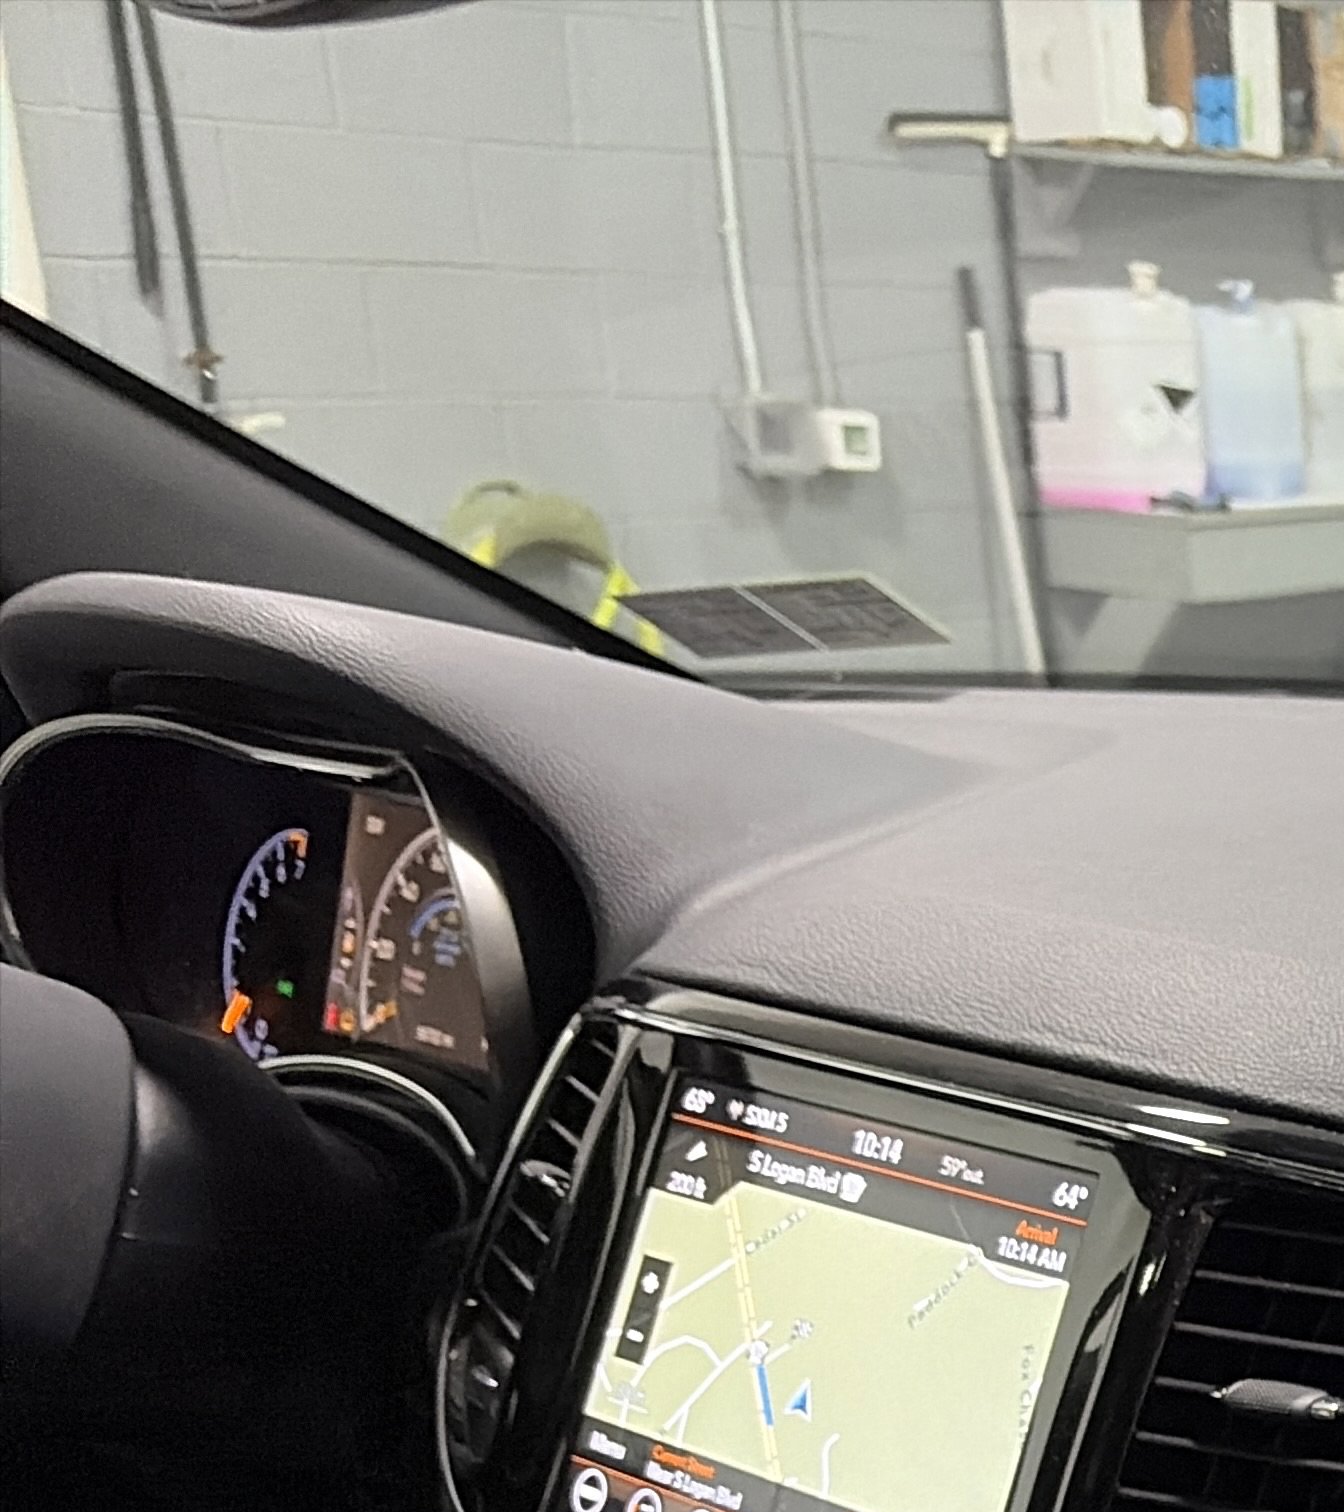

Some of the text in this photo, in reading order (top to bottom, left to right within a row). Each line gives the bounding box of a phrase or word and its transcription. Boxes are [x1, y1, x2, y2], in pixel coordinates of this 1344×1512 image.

[852, 1129, 903, 1164] 10:14
[747, 1150, 840, 1194] S Logan Blvd
[1052, 1182, 1089, 1209] 64°
[1016, 1219, 1060, 1245] Arrival
[998, 1236, 1039, 1265] 10:14
[1037, 1250, 1067, 1272] AM
